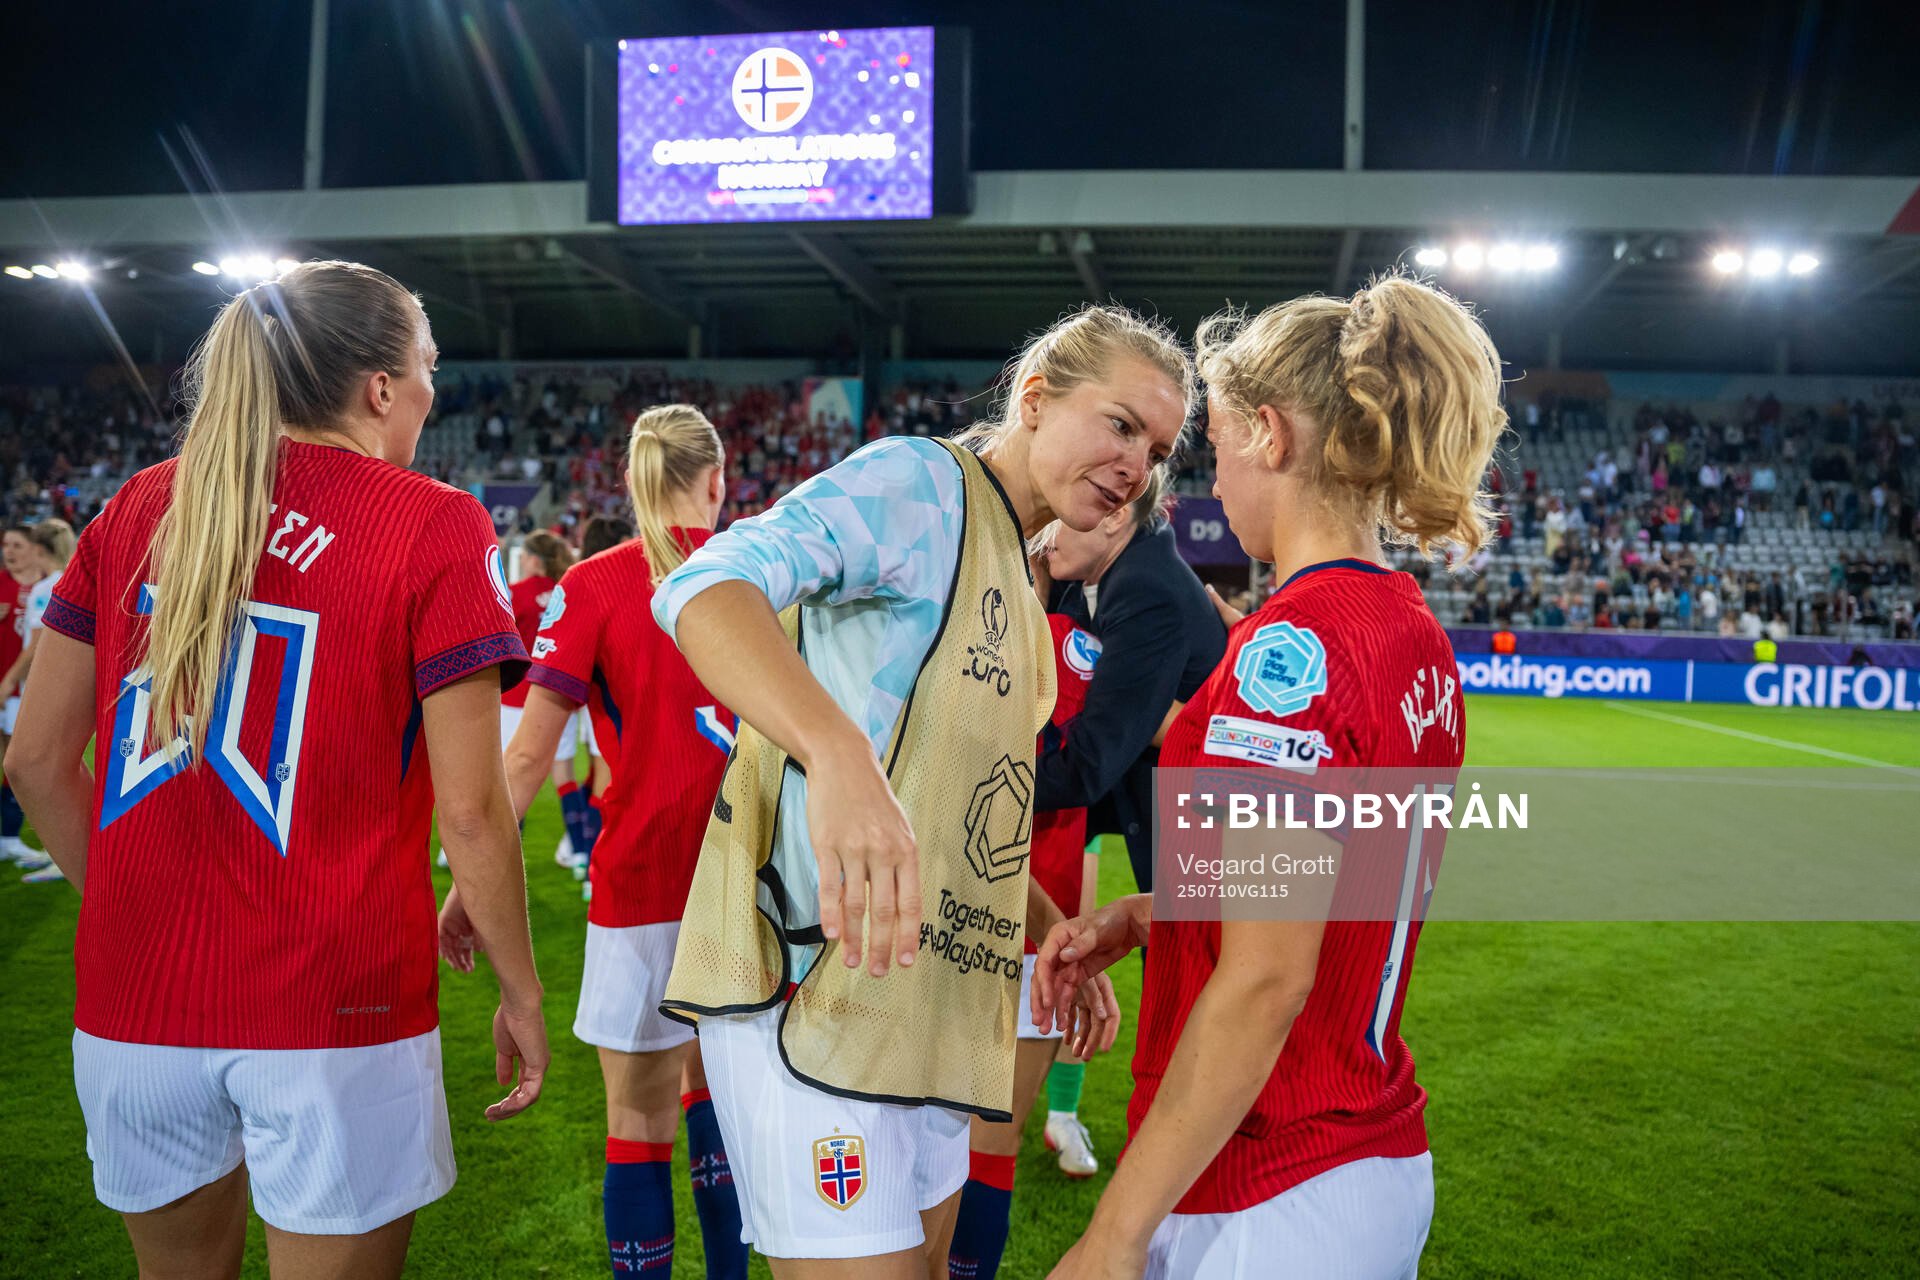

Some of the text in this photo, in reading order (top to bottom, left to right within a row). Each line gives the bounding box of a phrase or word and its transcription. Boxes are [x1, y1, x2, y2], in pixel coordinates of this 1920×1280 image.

[267, 503, 336, 573] EN
[1260, 669, 1297, 688] Strong
[1744, 662, 1920, 711] GRIFOL
[1209, 730, 1282, 751] FOUNDATION
[1285, 736, 1316, 762] 10
[938, 889, 1022, 941] Together
